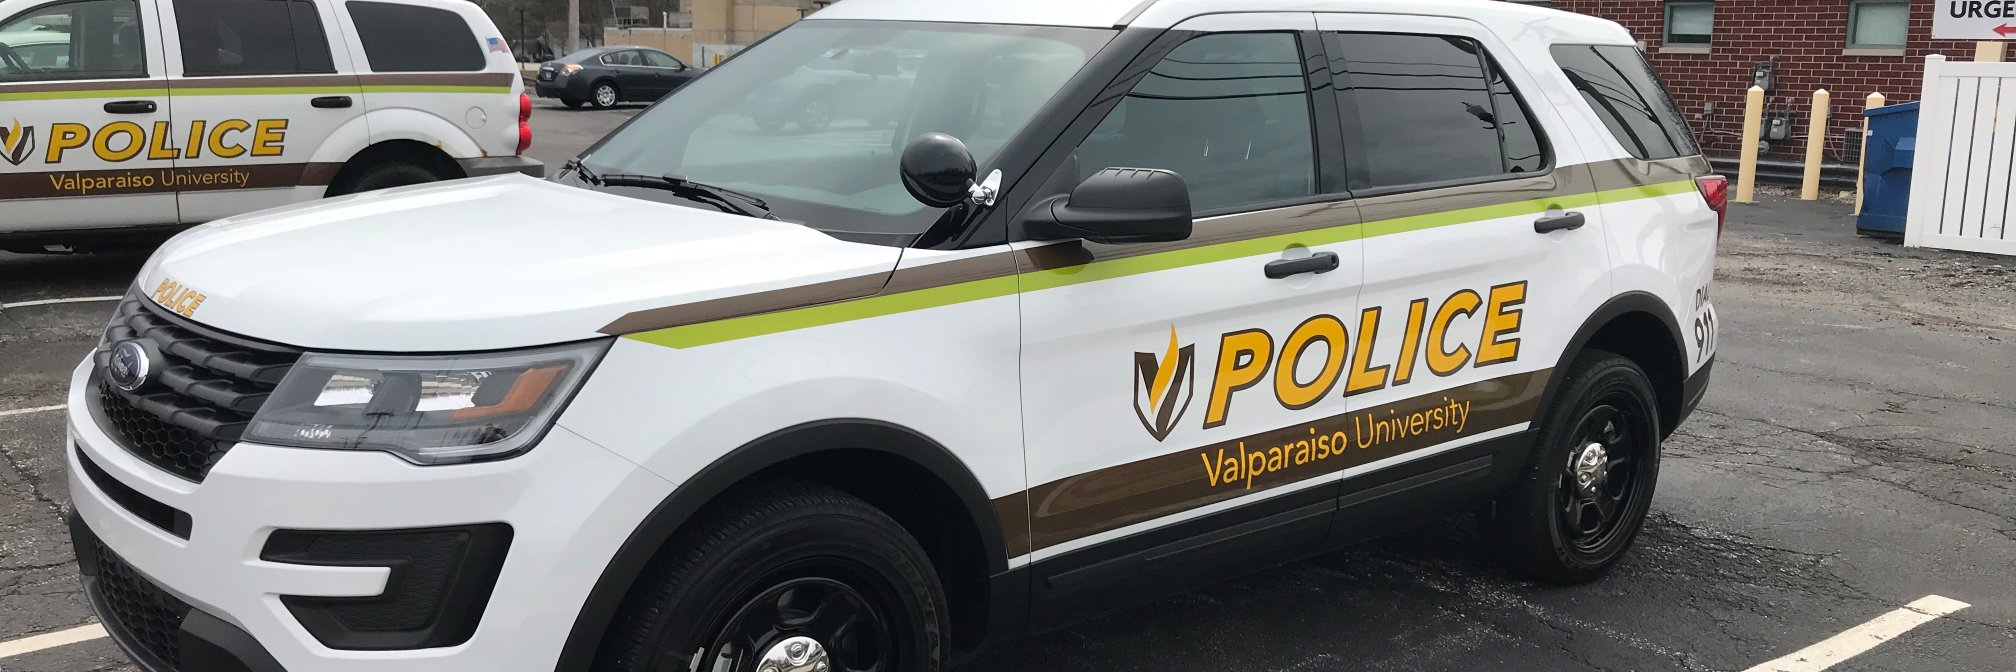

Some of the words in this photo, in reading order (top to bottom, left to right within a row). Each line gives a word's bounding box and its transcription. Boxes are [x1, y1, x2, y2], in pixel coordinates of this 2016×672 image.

[1950, 0, 2015, 19] URGE
[45, 119, 289, 164] POLICE
[50, 171, 154, 194] Valparaiso
[161, 168, 250, 187] University
[151, 278, 207, 318] POLICE
[1203, 280, 1528, 430] POLICE
[1694, 307, 1714, 364] 911
[1201, 428, 1347, 490] Valparaiso
[1355, 396, 1470, 449] University
